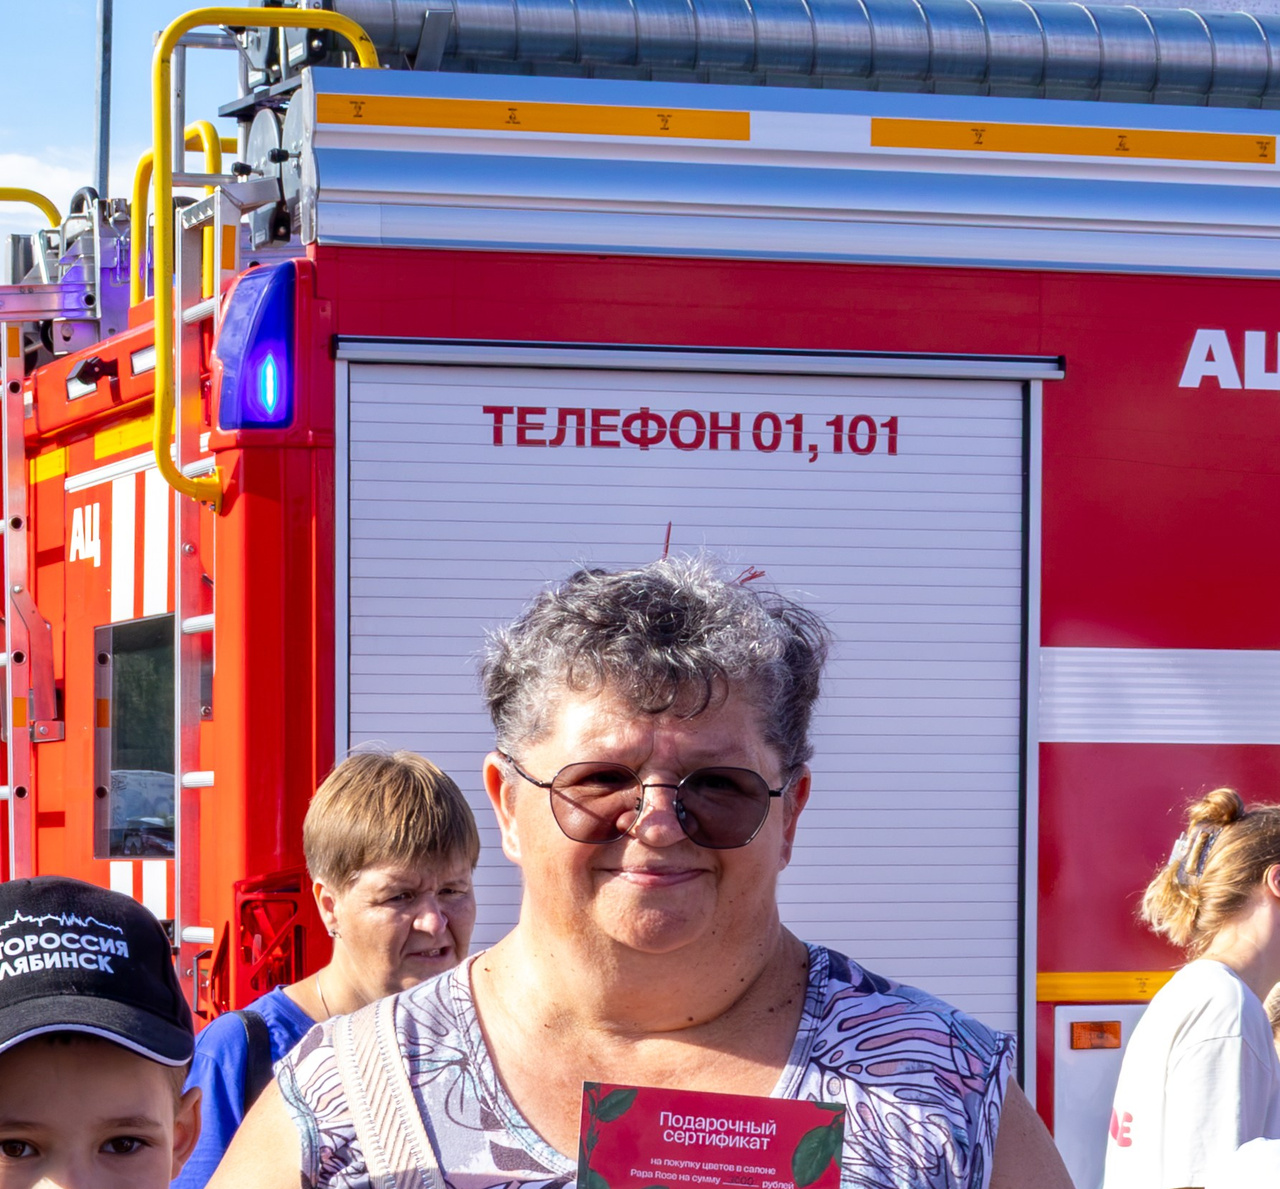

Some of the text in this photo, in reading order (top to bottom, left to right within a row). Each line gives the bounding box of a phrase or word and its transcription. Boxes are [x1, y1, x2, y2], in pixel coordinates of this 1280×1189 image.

[482, 405, 741, 452] ТЕЛЕФОН
[69, 502, 101, 568] АЦ
[659, 1111, 776, 1135] Подарочный
[663, 1128, 770, 1150] сертификат
[630, 1168, 653, 1179] Papa
[655, 1170, 677, 1180] Rose
[679, 1173, 690, 1181] на
[692, 1174, 721, 1185] сумму
[650, 1157, 776, 1175] на покупку цветов в салоне
